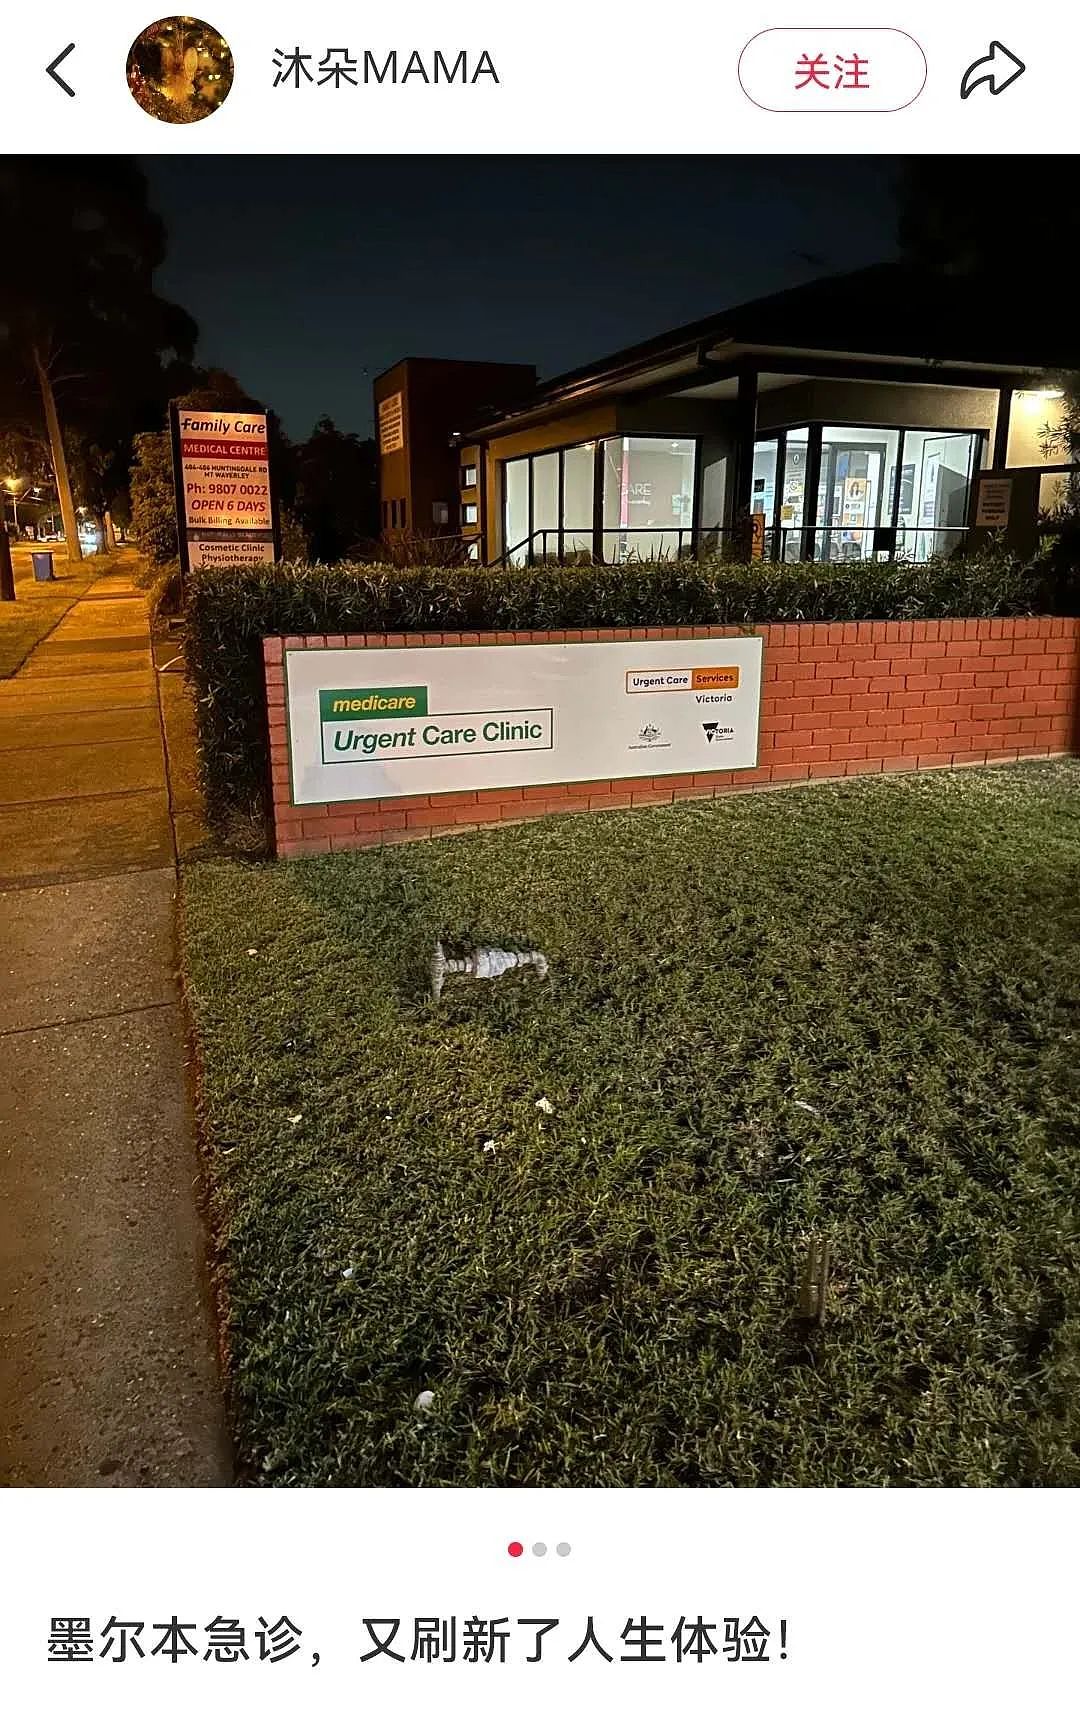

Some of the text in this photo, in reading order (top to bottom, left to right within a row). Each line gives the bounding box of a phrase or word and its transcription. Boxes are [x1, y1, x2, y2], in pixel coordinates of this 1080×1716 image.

[181, 418, 266, 435] Family Care
[184, 443, 267, 456] MEDICAL CENTRE
[187, 483, 268, 496] Ph: 9807 0022
[191, 499, 266, 512] OPEN 6 DAYS
[188, 516, 271, 526] Bulk Billing Available
[199, 543, 265, 552] Cosmetic Clinic
[202, 553, 264, 563] Physiotherapy
[633, 673, 734, 687] Urgent Care Services
[333, 694, 417, 713] medicare
[696, 694, 733, 703] Victoria
[333, 720, 543, 754] Urgent Care Clinic
